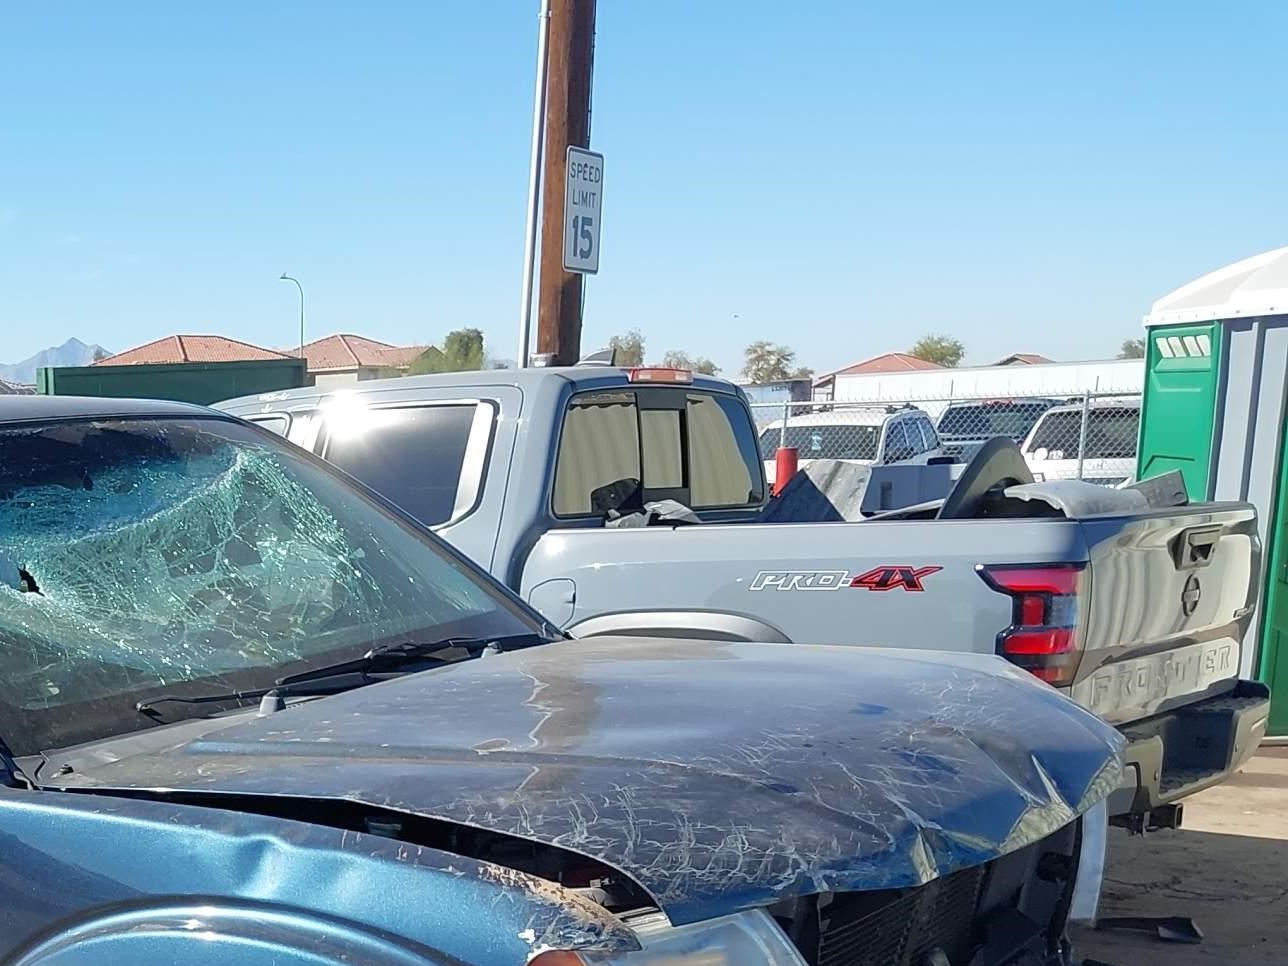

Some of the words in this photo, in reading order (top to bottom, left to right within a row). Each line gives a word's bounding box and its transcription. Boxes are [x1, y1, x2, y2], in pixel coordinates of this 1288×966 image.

[569, 161, 601, 184] SPEED
[571, 188, 597, 209] LIMIT
[572, 215, 593, 259] 15
[748, 566, 944, 592] PRO-4X
